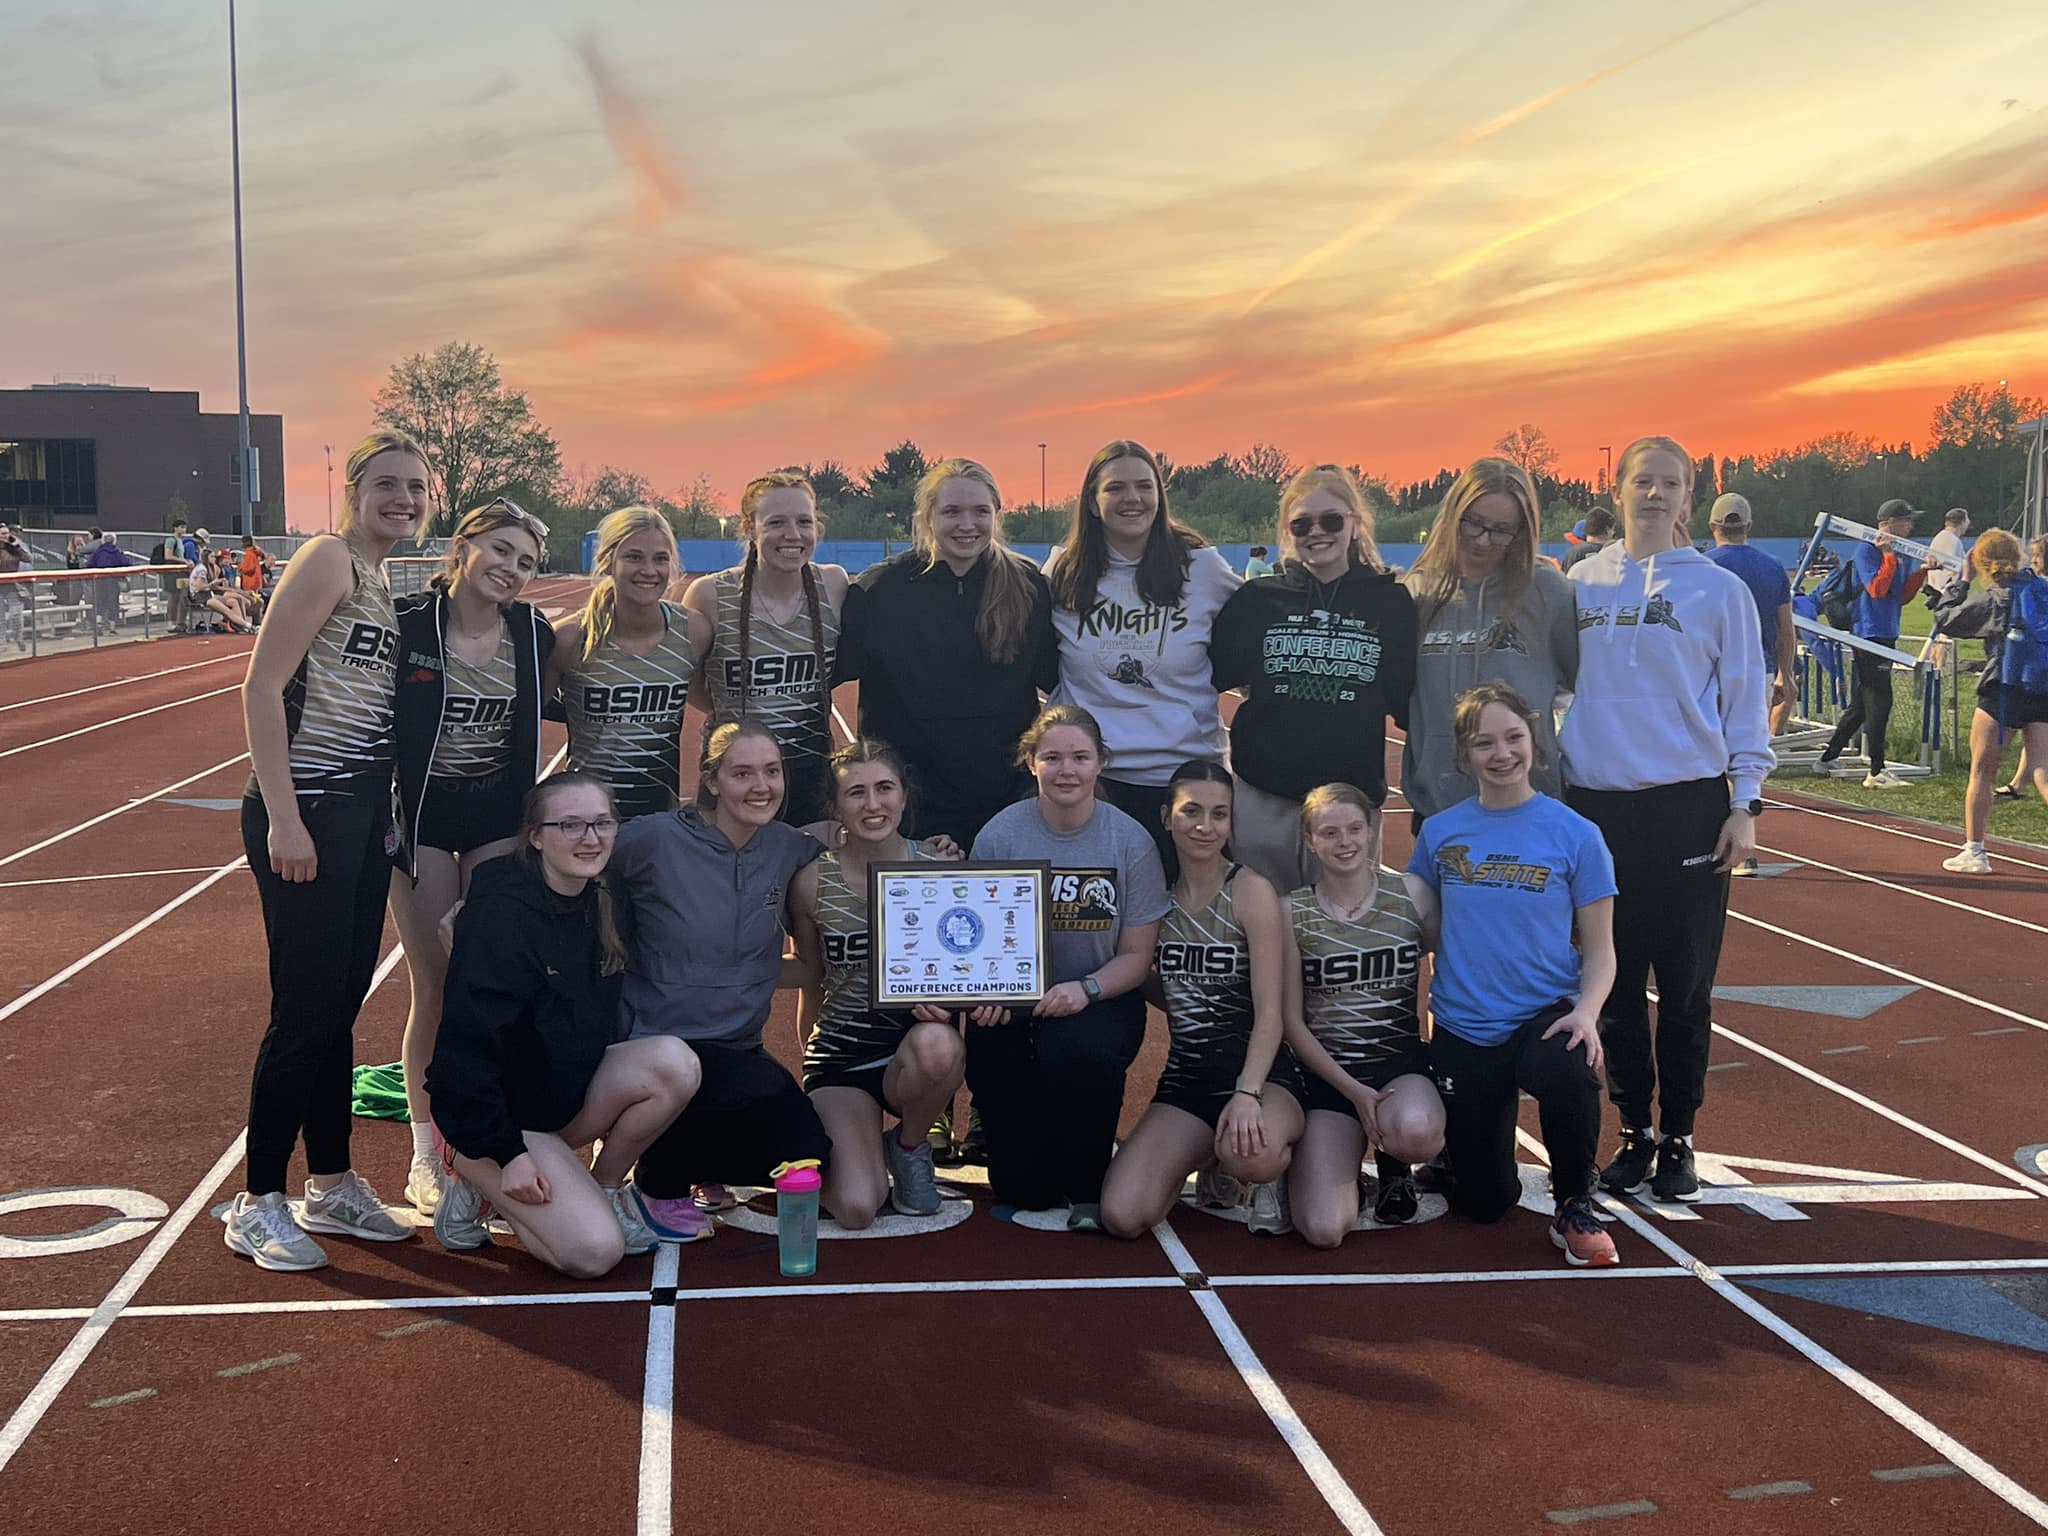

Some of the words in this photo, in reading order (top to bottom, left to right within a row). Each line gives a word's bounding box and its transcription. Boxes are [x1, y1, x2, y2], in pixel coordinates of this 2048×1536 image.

[1263, 635, 1381, 666] CONFERENCE
[340, 654, 383, 673] TRACK
[1263, 656, 1377, 682] CHAMPS
[1274, 684, 1289, 694] 22
[1340, 690, 1355, 701] 23
[1471, 862, 1552, 886] STATE
[1053, 920, 1109, 930] HAMPIONS
[1303, 944, 1418, 987] BSMS
[890, 984, 964, 994] CONFERENCE
[966, 982, 1032, 993] CHAMPIONS
